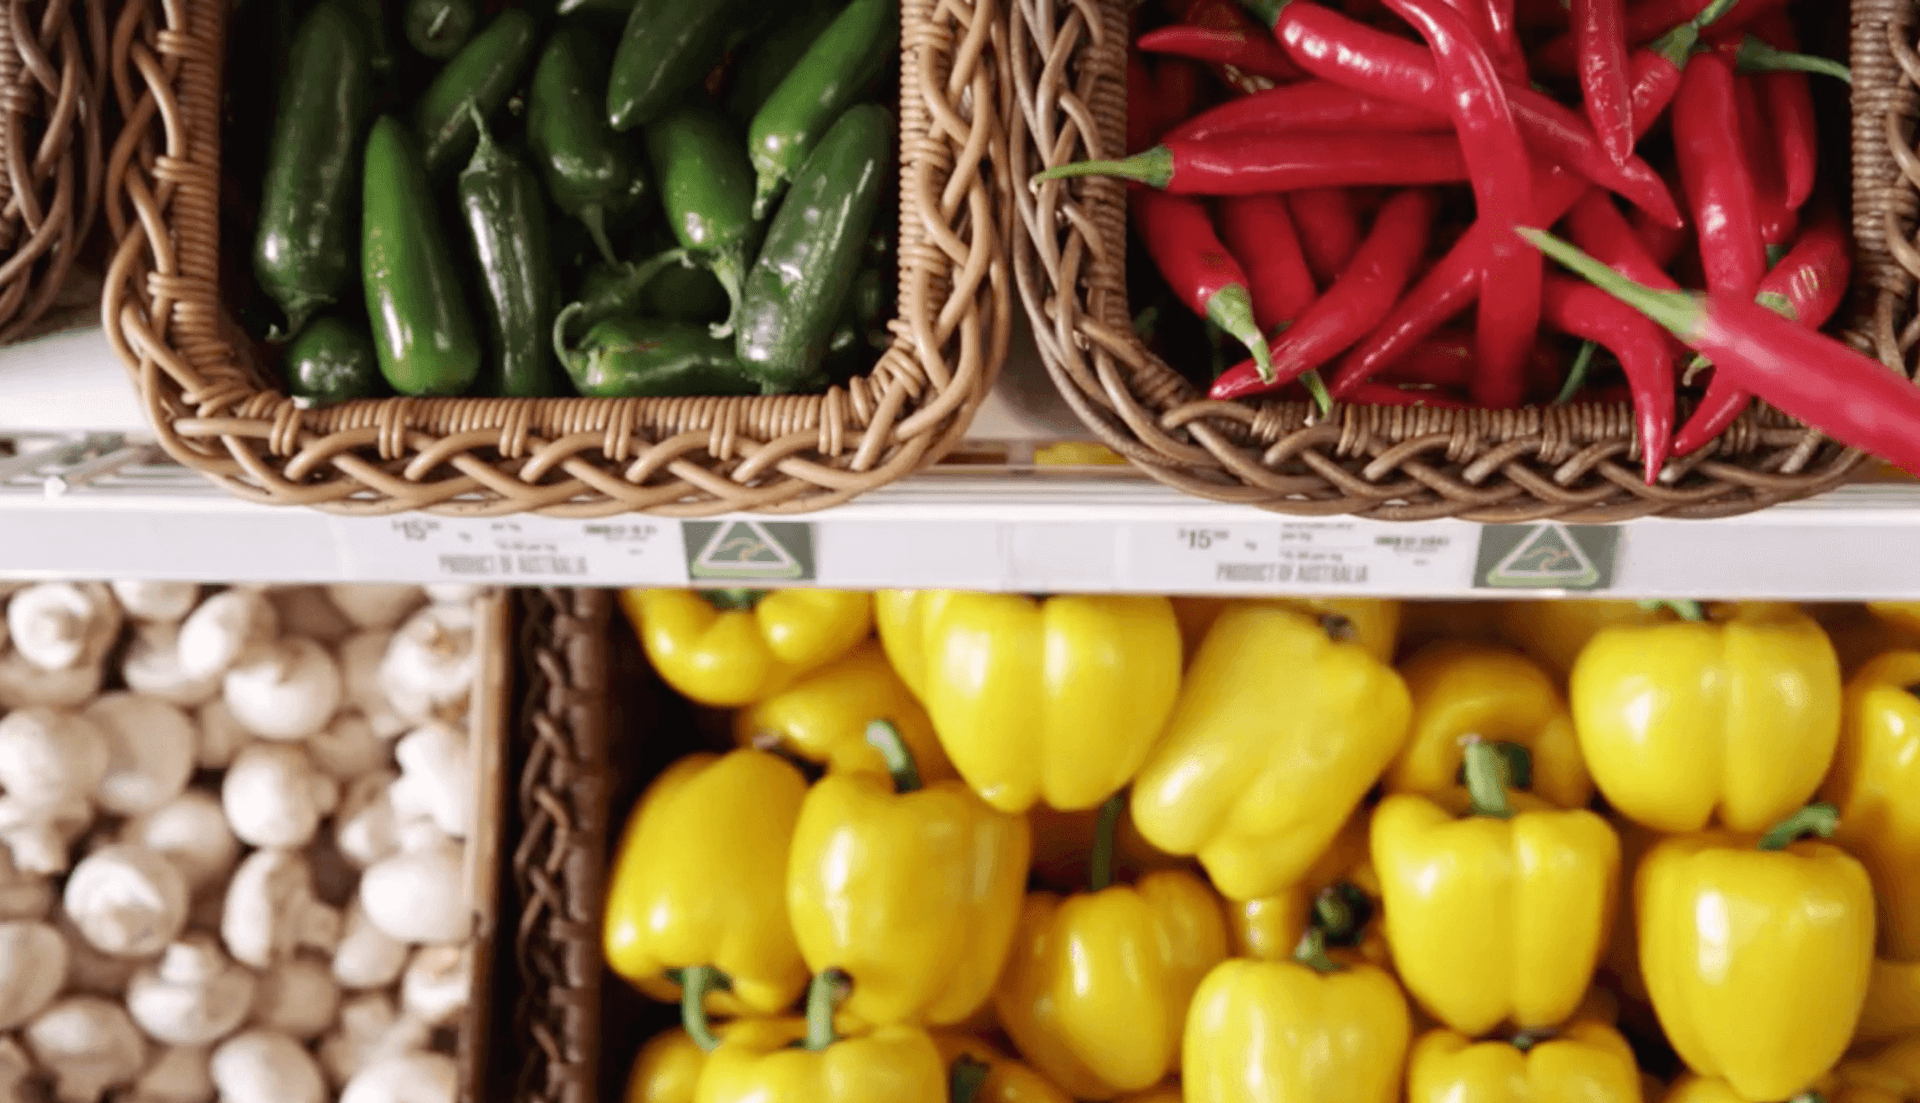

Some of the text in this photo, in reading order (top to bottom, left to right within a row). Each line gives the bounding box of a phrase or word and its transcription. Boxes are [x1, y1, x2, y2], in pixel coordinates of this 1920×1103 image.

[438, 554, 495, 574] PRODUCT
[517, 555, 588, 575] AUSTRALIA
[1216, 562, 1369, 583] PRODUCT OF AUSTRALIA
